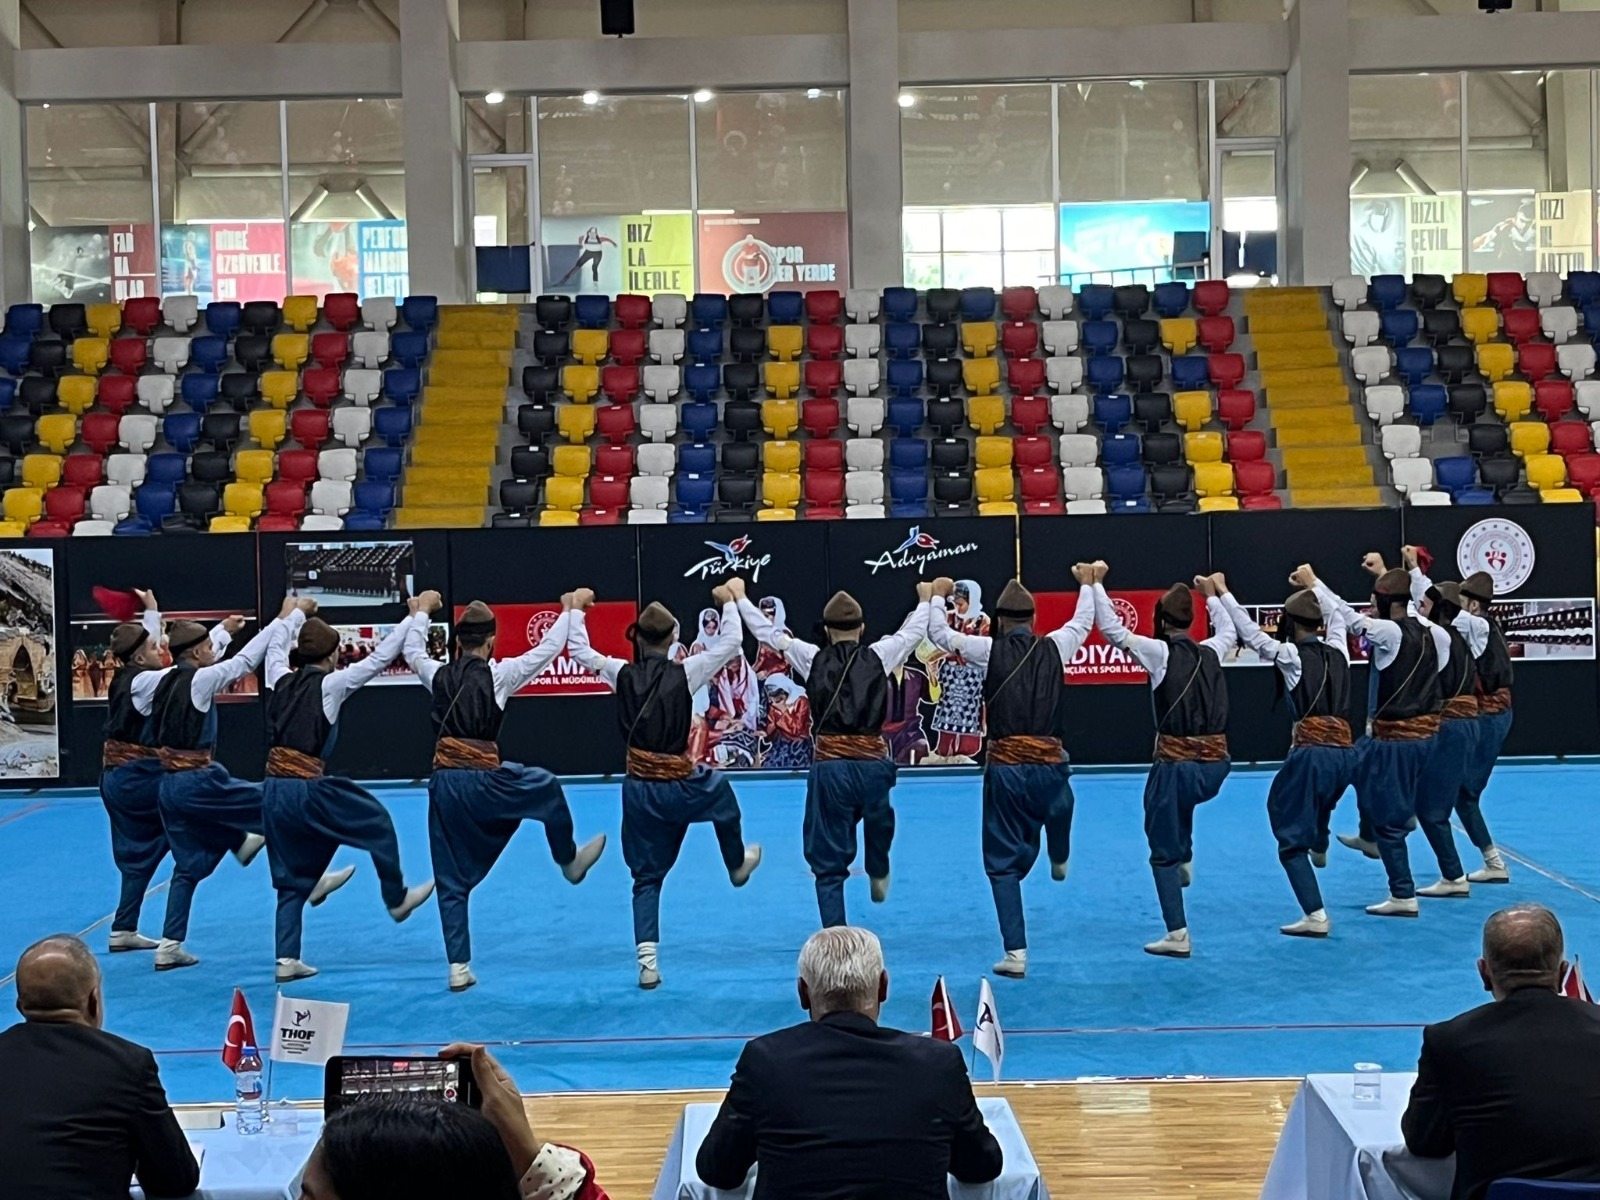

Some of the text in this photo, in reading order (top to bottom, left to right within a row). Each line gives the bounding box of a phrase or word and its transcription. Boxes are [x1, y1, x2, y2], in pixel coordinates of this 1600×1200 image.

[627, 223, 653, 243] HIZ
[628, 247, 646, 267] LA
[629, 270, 681, 291] İLERLE
[796, 264, 836, 282] YERDE
[683, 553, 771, 584] Türkiye
[863, 542, 979, 575] Adıyaman
[1065, 644, 1132, 665] DIYA
[1087, 666, 1099, 674] VE
[1100, 665, 1121, 674] SPOR
[1122, 664, 1130, 673] İL
[552, 675, 560, 685] İL
[561, 675, 602, 685] MÜDÜRLÜ
[281, 1028, 315, 1040] THOF
